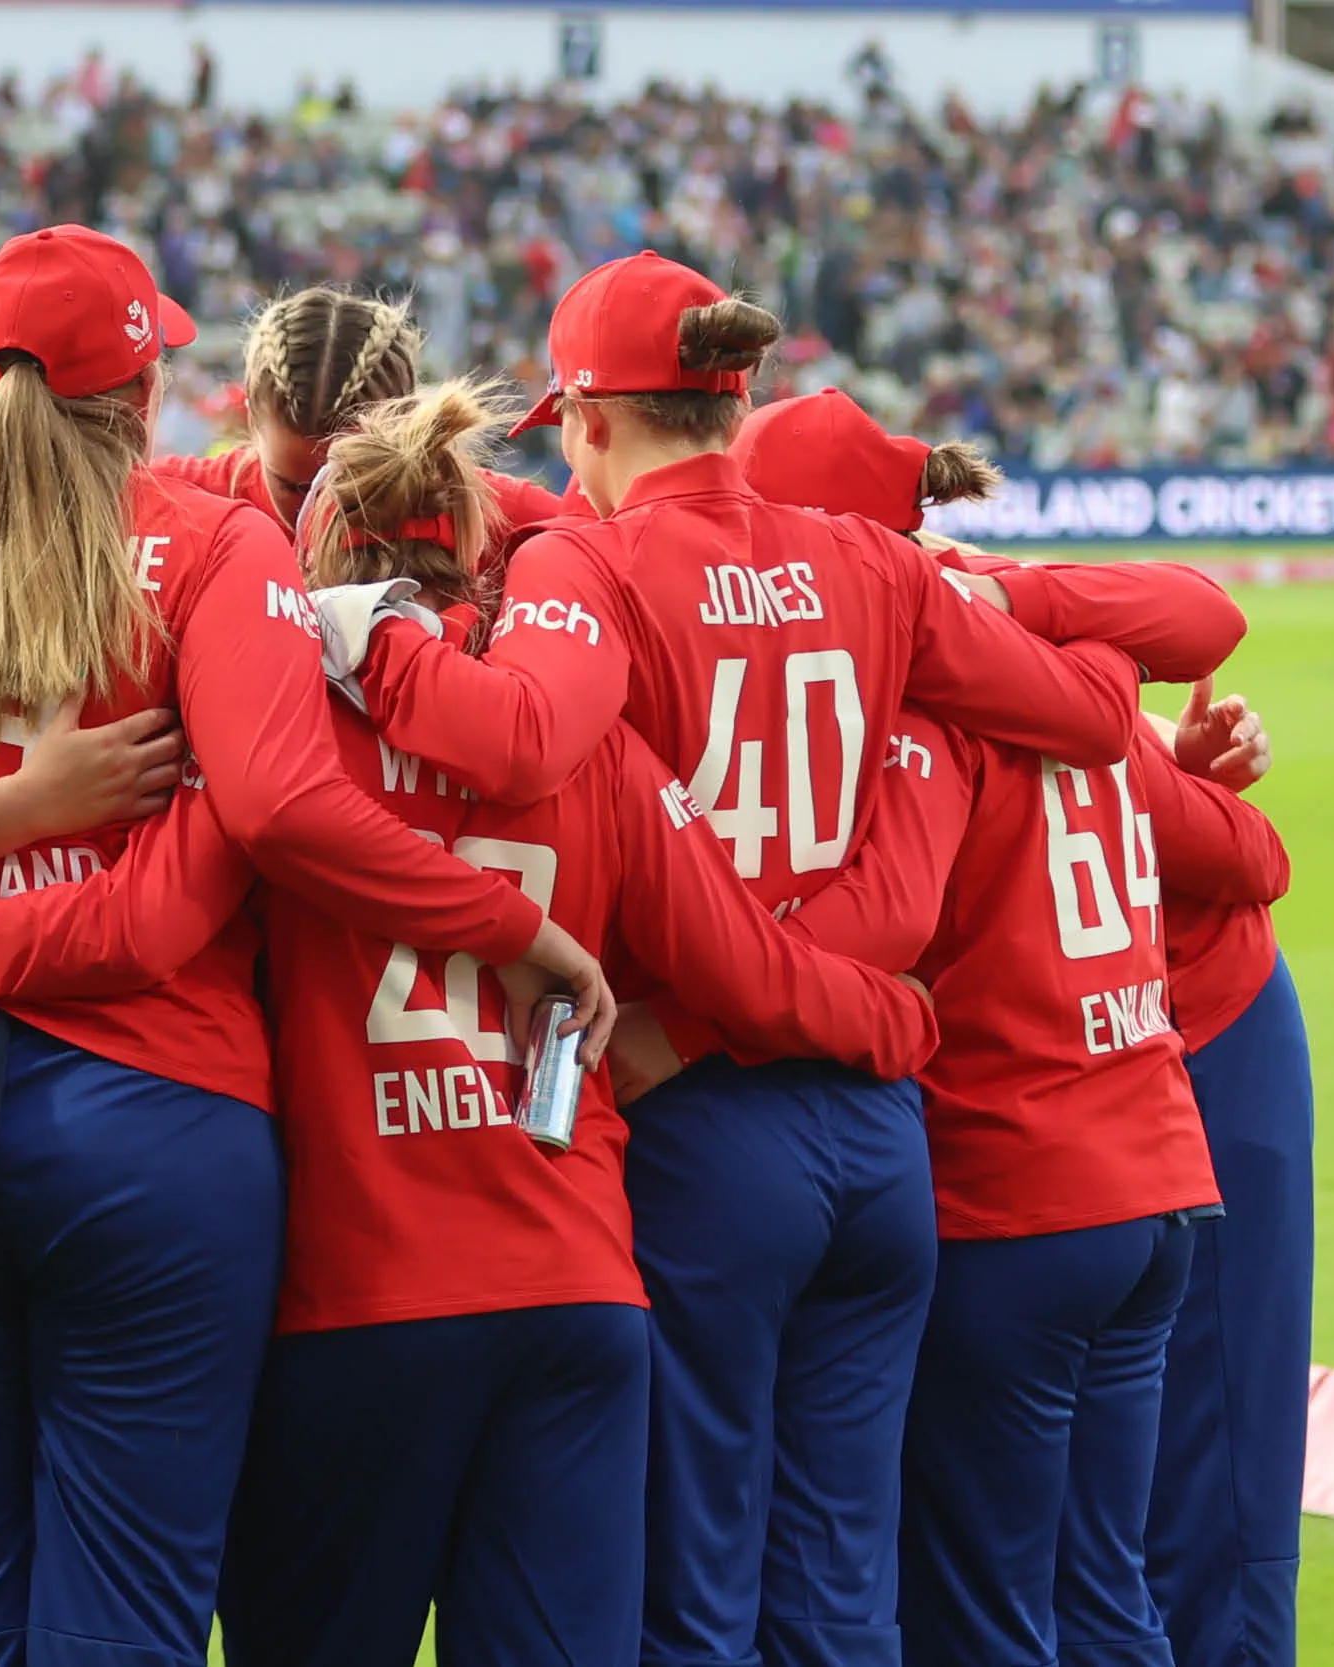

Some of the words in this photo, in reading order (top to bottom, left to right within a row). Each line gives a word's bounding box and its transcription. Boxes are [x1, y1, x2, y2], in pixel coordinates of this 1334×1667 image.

[128, 299, 141, 320] 50
[574, 369, 593, 387] 33
[699, 562, 823, 627] JONES
[686, 649, 865, 879] 40
[1041, 755, 1161, 960] 64
[373, 1065, 513, 1136] ENGL
